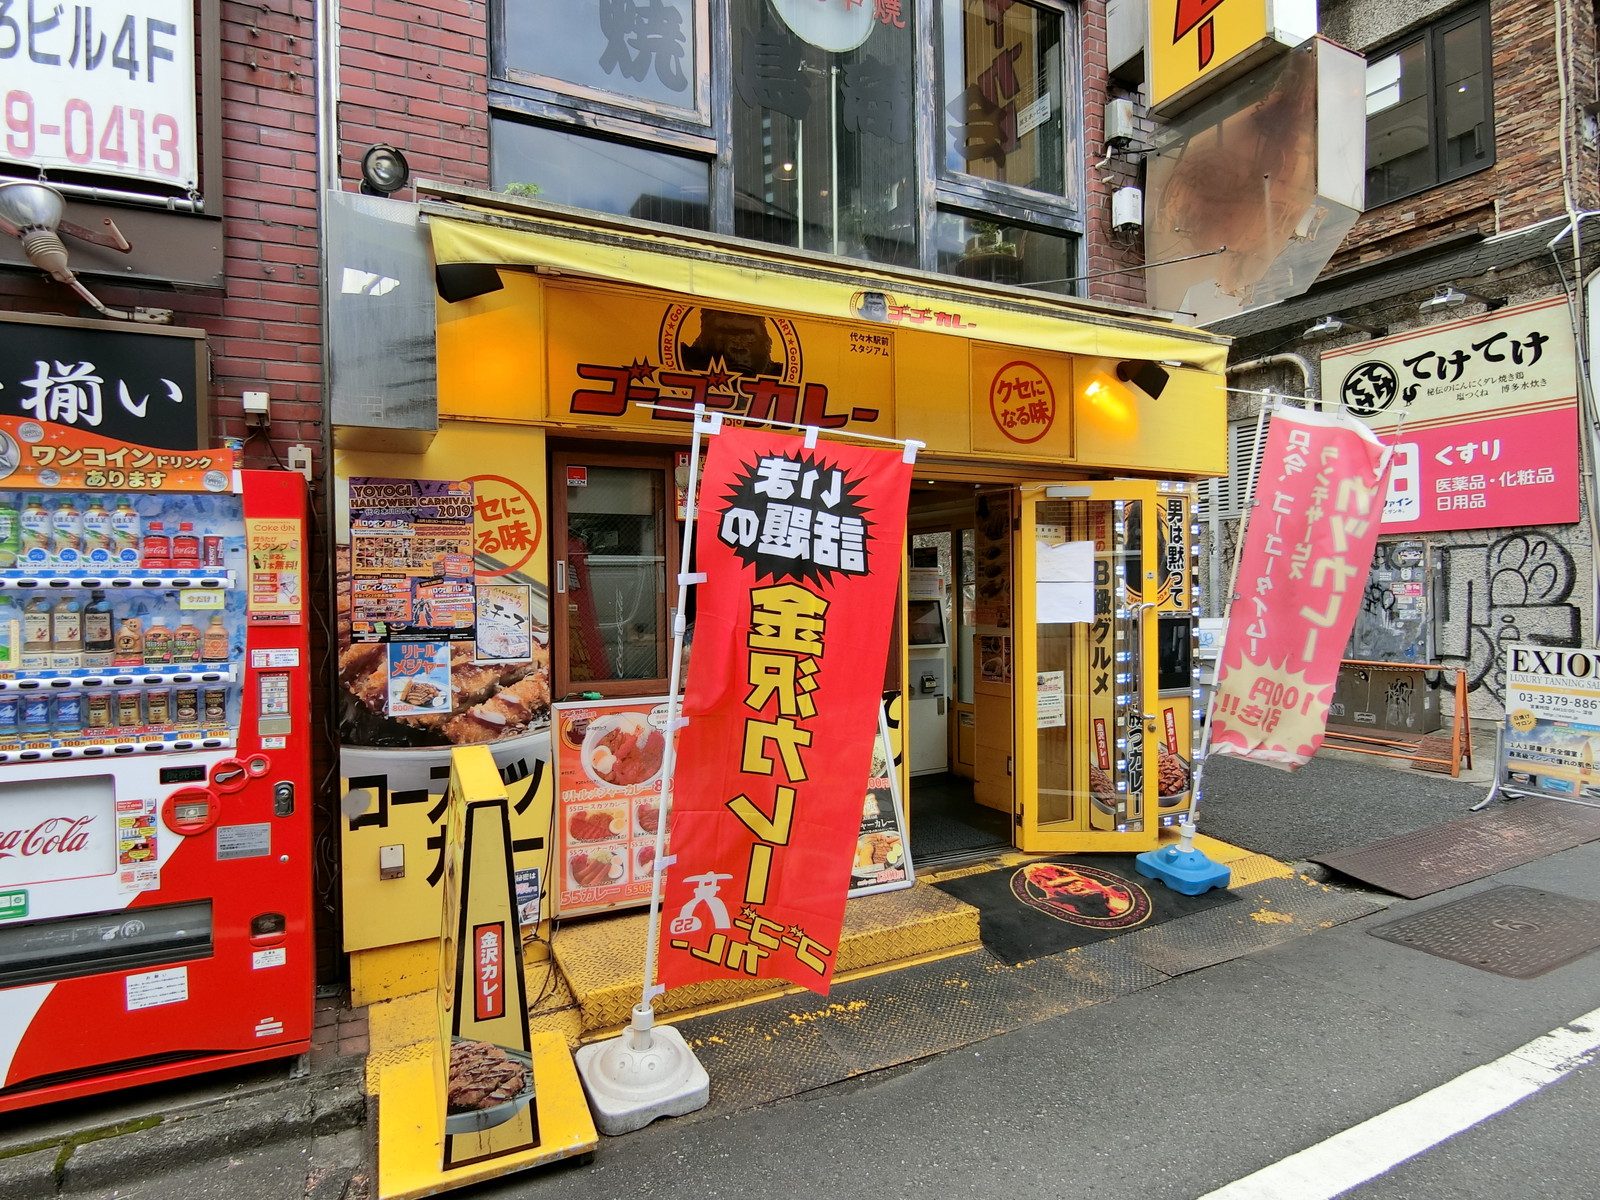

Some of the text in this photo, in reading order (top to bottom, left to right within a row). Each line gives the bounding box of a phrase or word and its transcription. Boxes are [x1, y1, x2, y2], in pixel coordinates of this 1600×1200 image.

[888, 304, 977, 329] ゴーゴーカレー
[850, 331, 890, 347] 代々木駅前
[850, 343, 890, 357] スタジアム
[1402, 331, 1550, 383] てけてけ
[20, 360, 184, 427] 揃い
[569, 355, 879, 432] ゴーゴーカレー
[997, 377, 1046, 404] クセに
[1001, 399, 1051, 429] なる味
[31, 445, 213, 469] ワンコインドリンク
[1434, 439, 1502, 466] くすり
[85, 470, 167, 489] あります
[353, 484, 412, 498] YOYOGI
[1435, 467, 1555, 493] 医薬品・化粧品
[350, 496, 473, 508] HALLOWEEN CARNIVAL
[437, 505, 471, 518] 2019
[475, 495, 526, 523] セに
[1436, 493, 1487, 511] 日用品
[253, 524, 279, 532] Coke
[474, 520, 532, 555] る味
[253, 543, 289, 551] スタンプ
[1166, 498, 1185, 608] 男は黙って
[1092, 560, 1112, 696] B級グルメ
[401, 644, 438, 659] リトル
[391, 659, 447, 677] メジャー
[1510, 674, 1543, 684] LUXURY
[1544, 677, 1585, 689] TANNING
[1165, 711, 1176, 751] 金沢カレー
[1095, 720, 1107, 769] 金沢カレー
[562, 784, 654, 803] リトルメジャーカレー
[867, 777, 890, 790] 00円
[561, 887, 621, 906] 55カレー
[479, 930, 498, 1015] 金沢カレー
